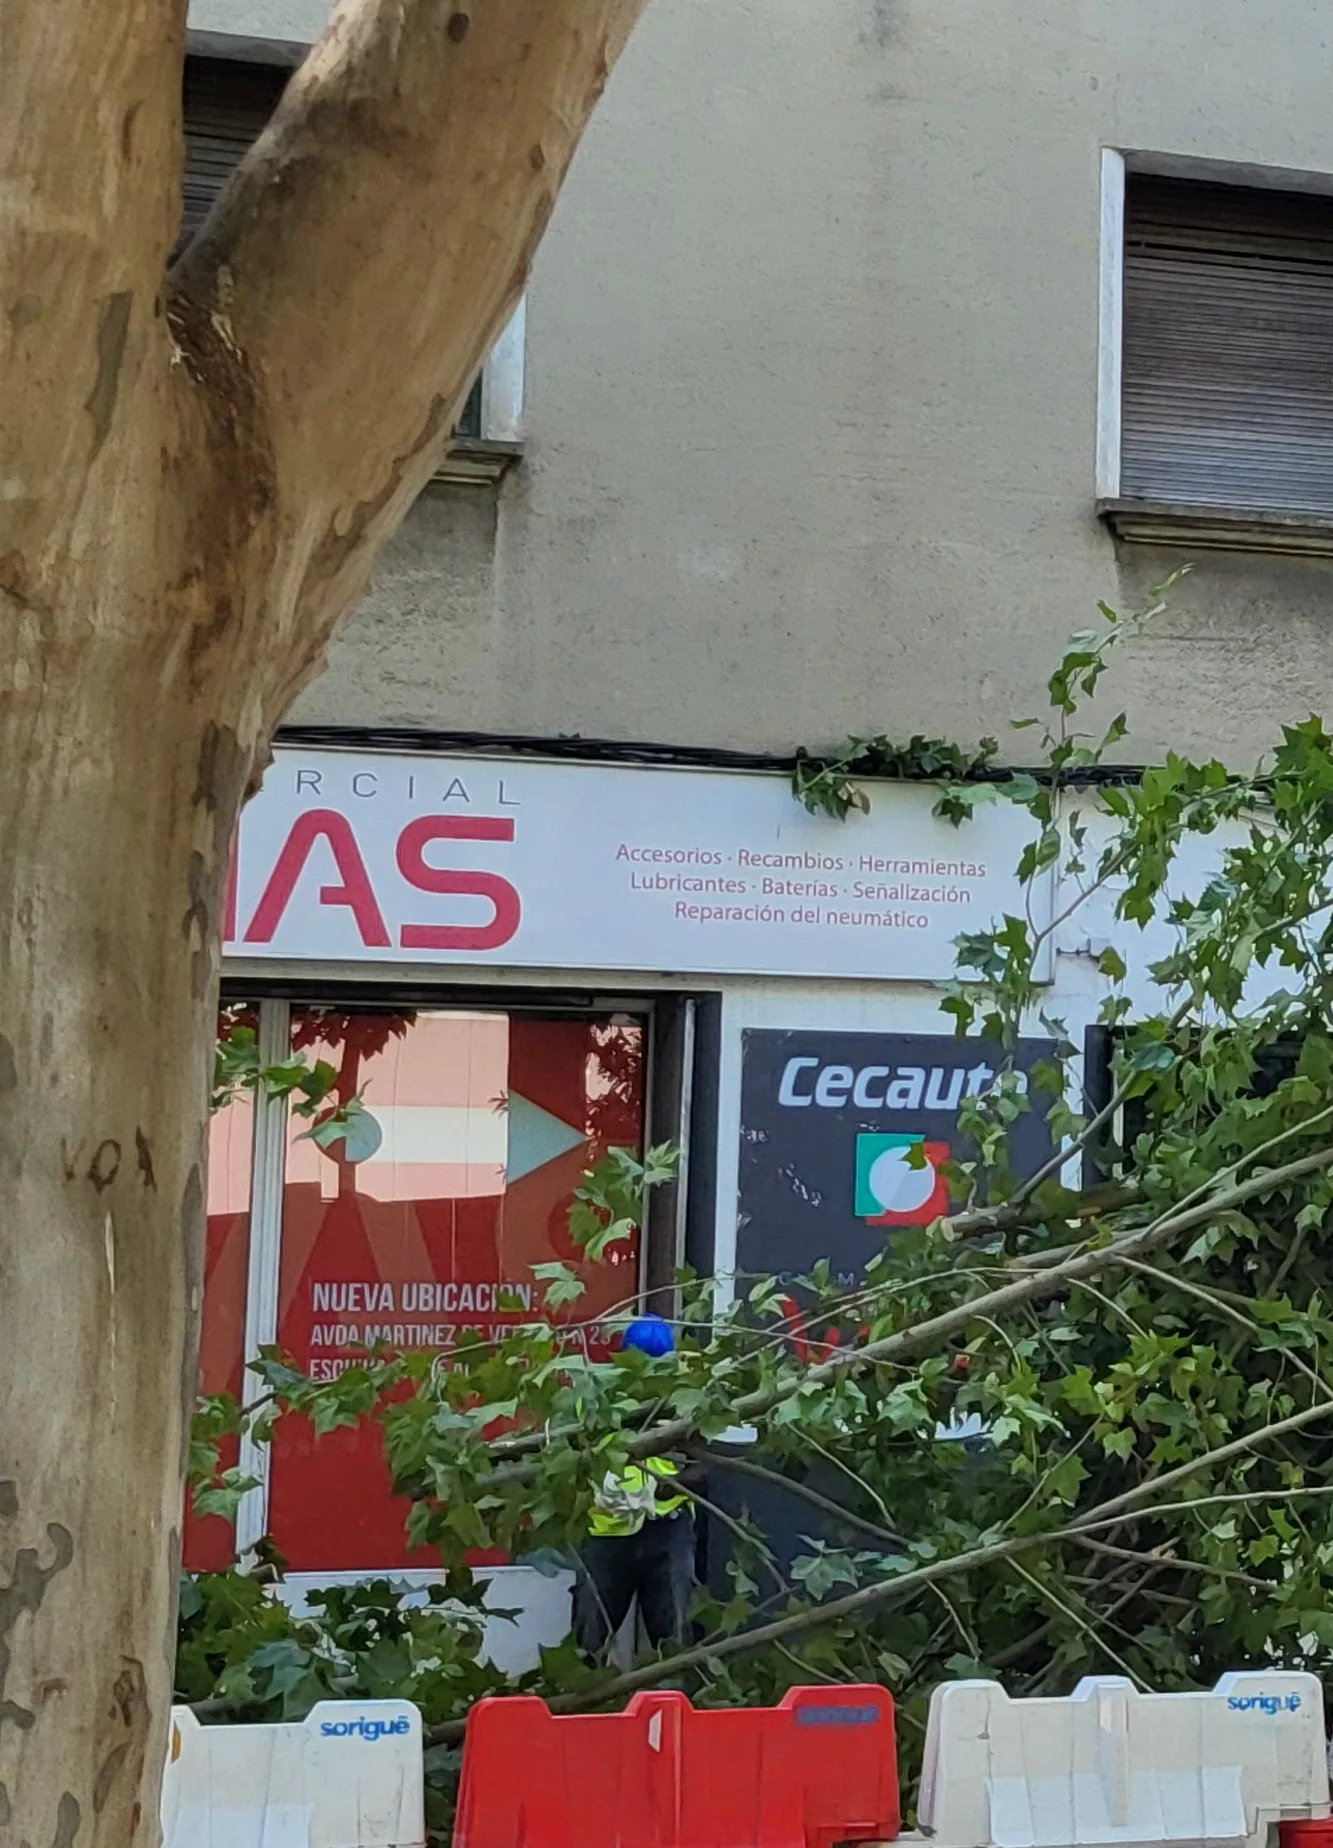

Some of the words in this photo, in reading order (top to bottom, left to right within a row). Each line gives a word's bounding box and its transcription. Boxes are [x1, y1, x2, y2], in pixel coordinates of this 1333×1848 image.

[296, 769, 522, 806] RCIAL
[615, 844, 722, 866] Accesorios
[738, 849, 844, 871] Recambios
[859, 855, 987, 878] Herramientas
[222, 808, 522, 951] AS
[630, 871, 747, 894] Lubricantes
[762, 877, 838, 898] Baterías
[852, 881, 971, 904] Señalización
[675, 901, 785, 927] Reparación
[790, 905, 820, 925] del
[826, 908, 929, 929] neumático
[313, 1283, 395, 1312] NUEVA
[311, 1324, 358, 1346] AVDA
[364, 1324, 456, 1347] MARTINEZ
